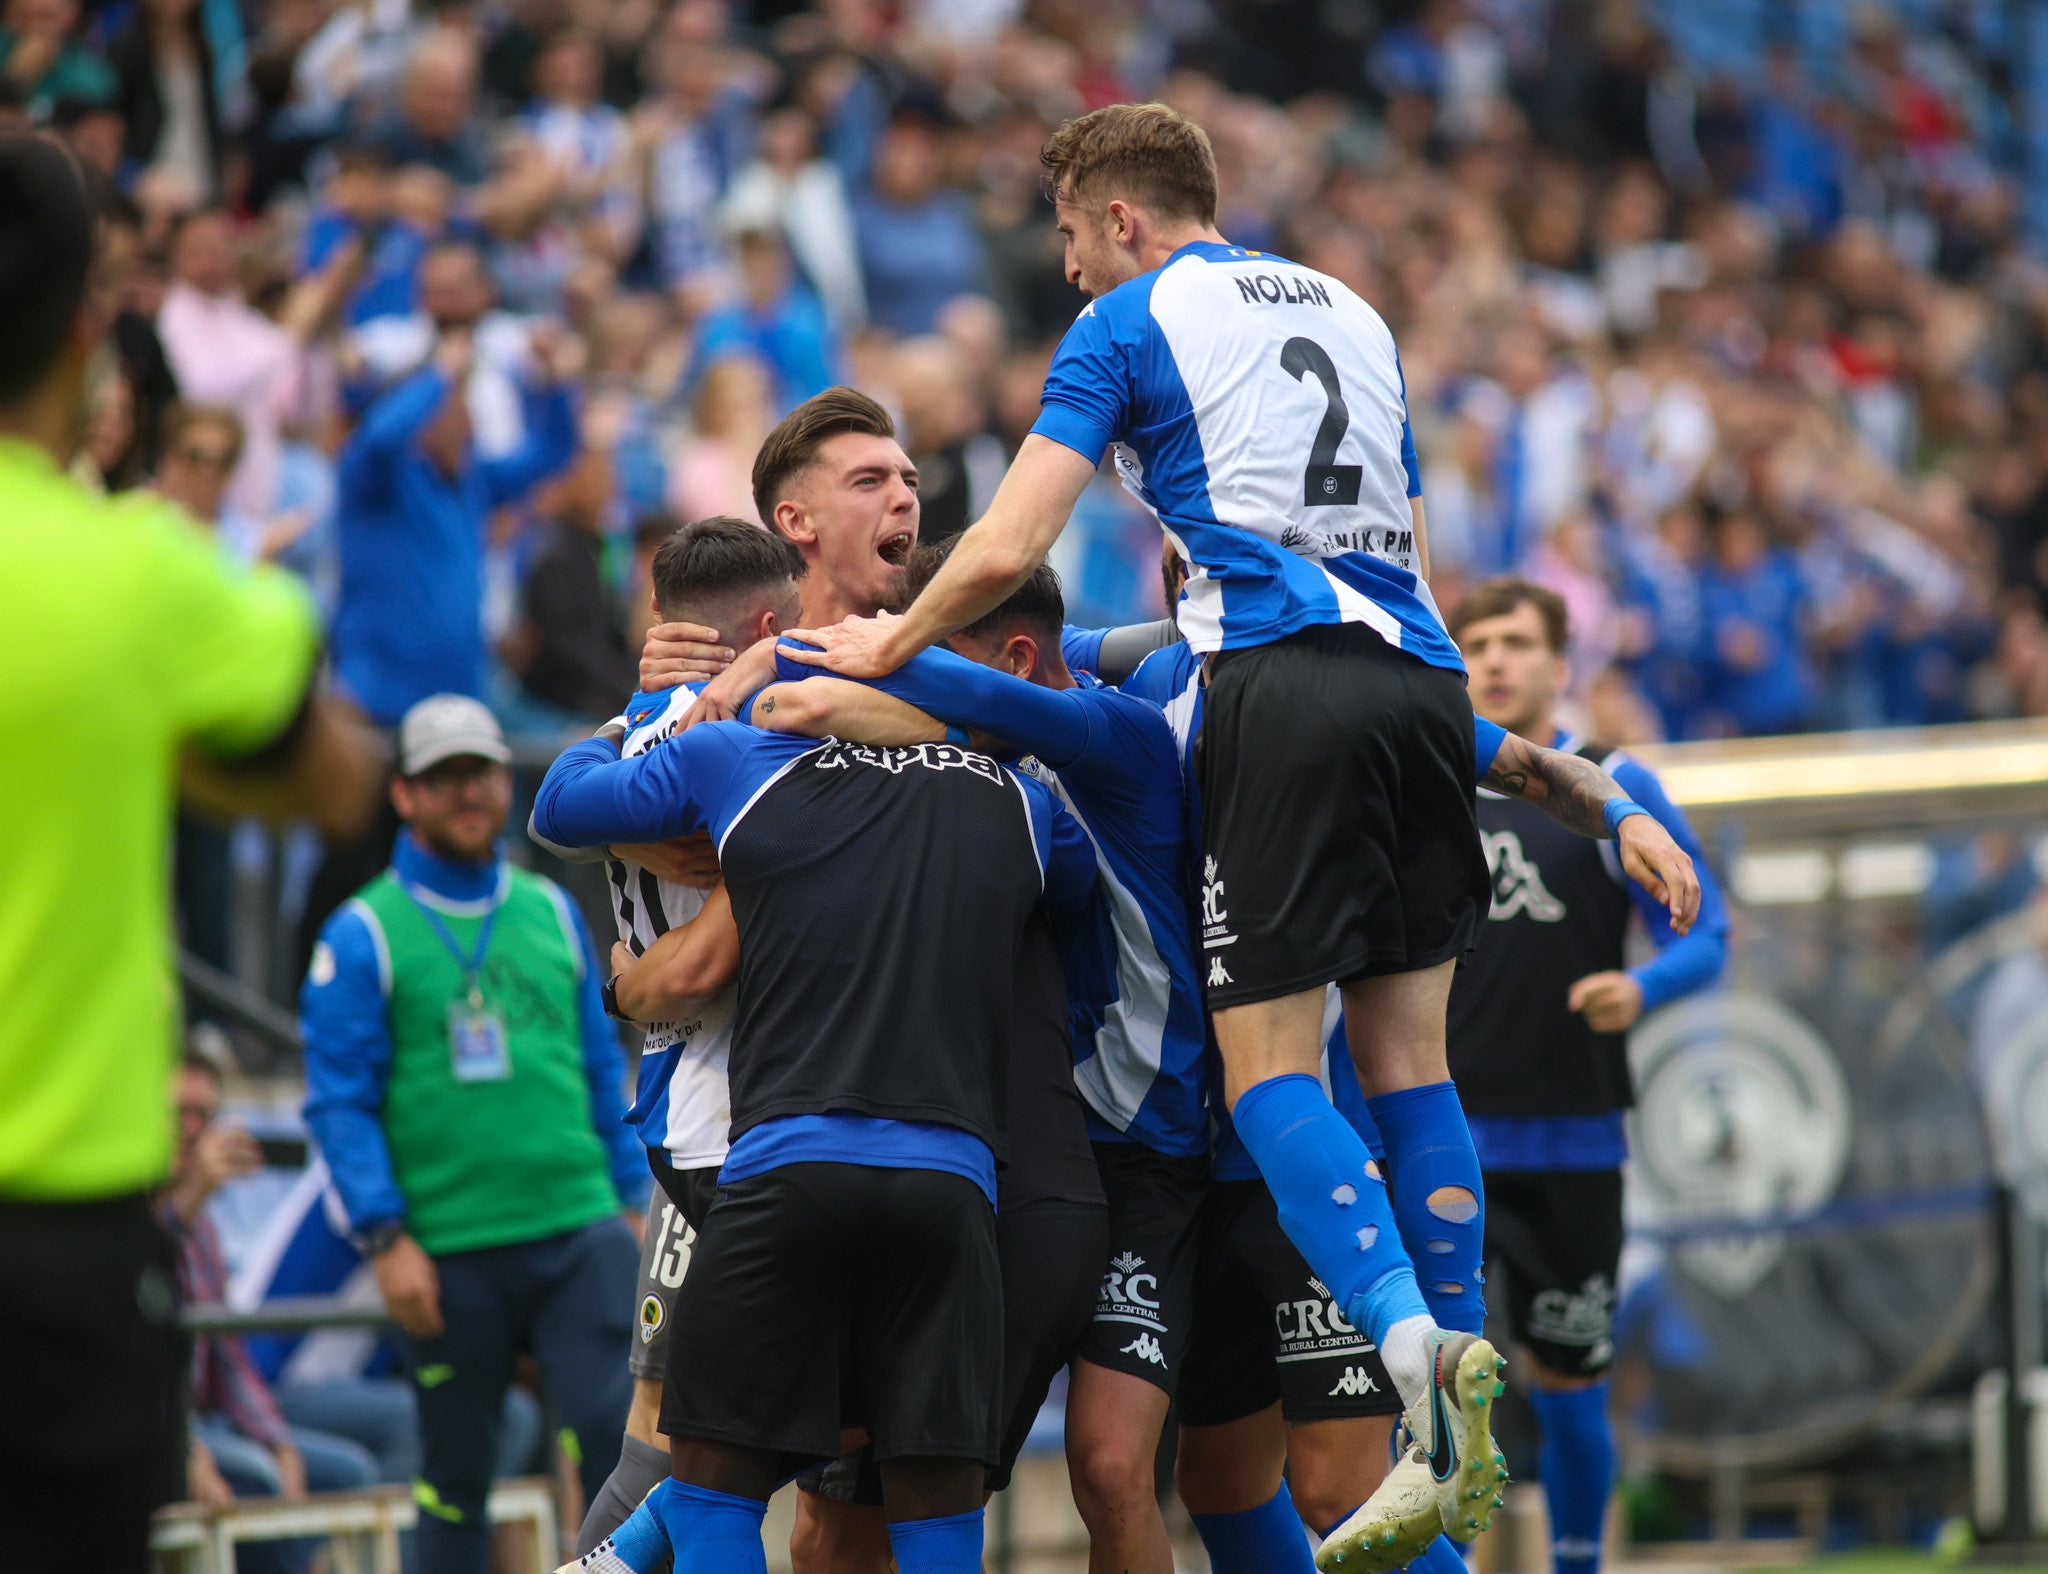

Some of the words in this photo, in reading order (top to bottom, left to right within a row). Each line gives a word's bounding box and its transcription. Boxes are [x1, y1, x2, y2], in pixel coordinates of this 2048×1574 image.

[1233, 274, 1332, 309] NOLAN
[1279, 336, 1363, 507] 2
[1384, 530, 1412, 553] PM
[1202, 880, 1228, 926] RC
[649, 1202, 697, 1290] 13
[1112, 1303, 1160, 1321] CENTRAL
[1289, 1340, 1318, 1353] RURAL
[1318, 1334, 1368, 1349] CENTRAL
